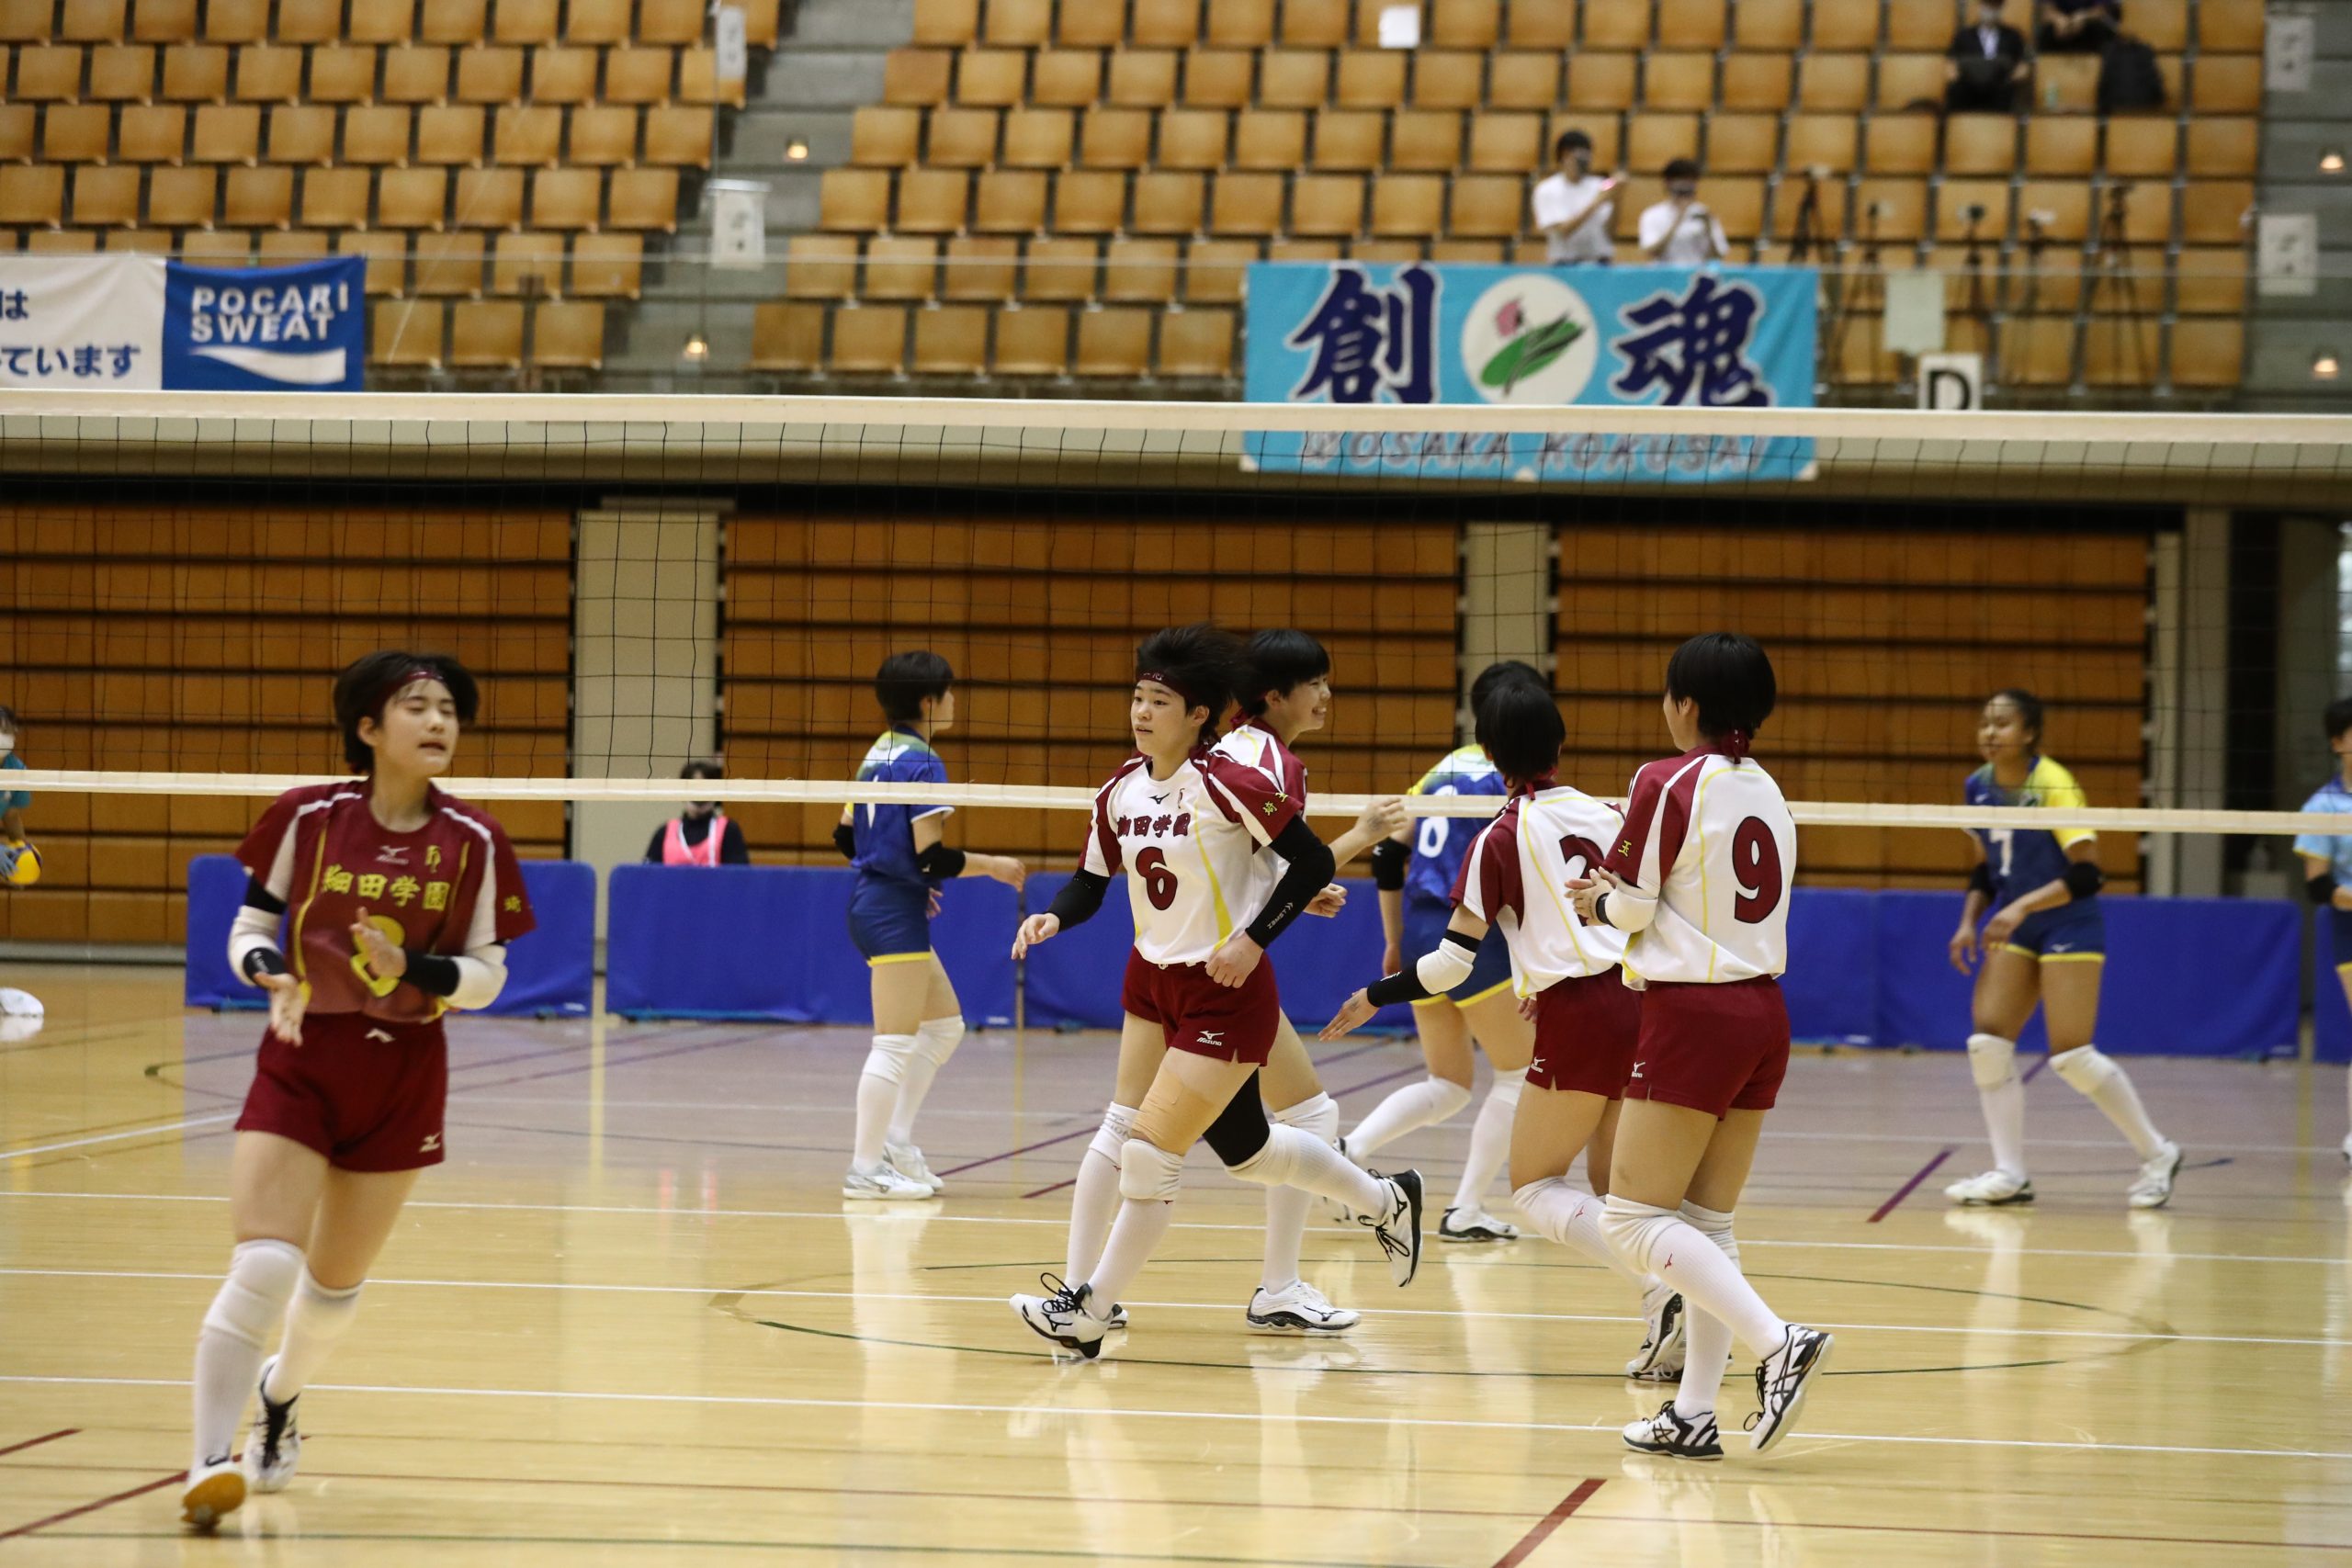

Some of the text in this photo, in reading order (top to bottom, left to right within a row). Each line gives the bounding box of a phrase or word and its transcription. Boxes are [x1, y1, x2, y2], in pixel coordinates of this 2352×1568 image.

[191, 281, 349, 314] POCARI
[190, 312, 333, 344] SWEAT
[0, 344, 141, 378] ています
[1928, 369, 1972, 411] D
[1136, 846, 1178, 911] 6
[1732, 815, 1782, 924] 9
